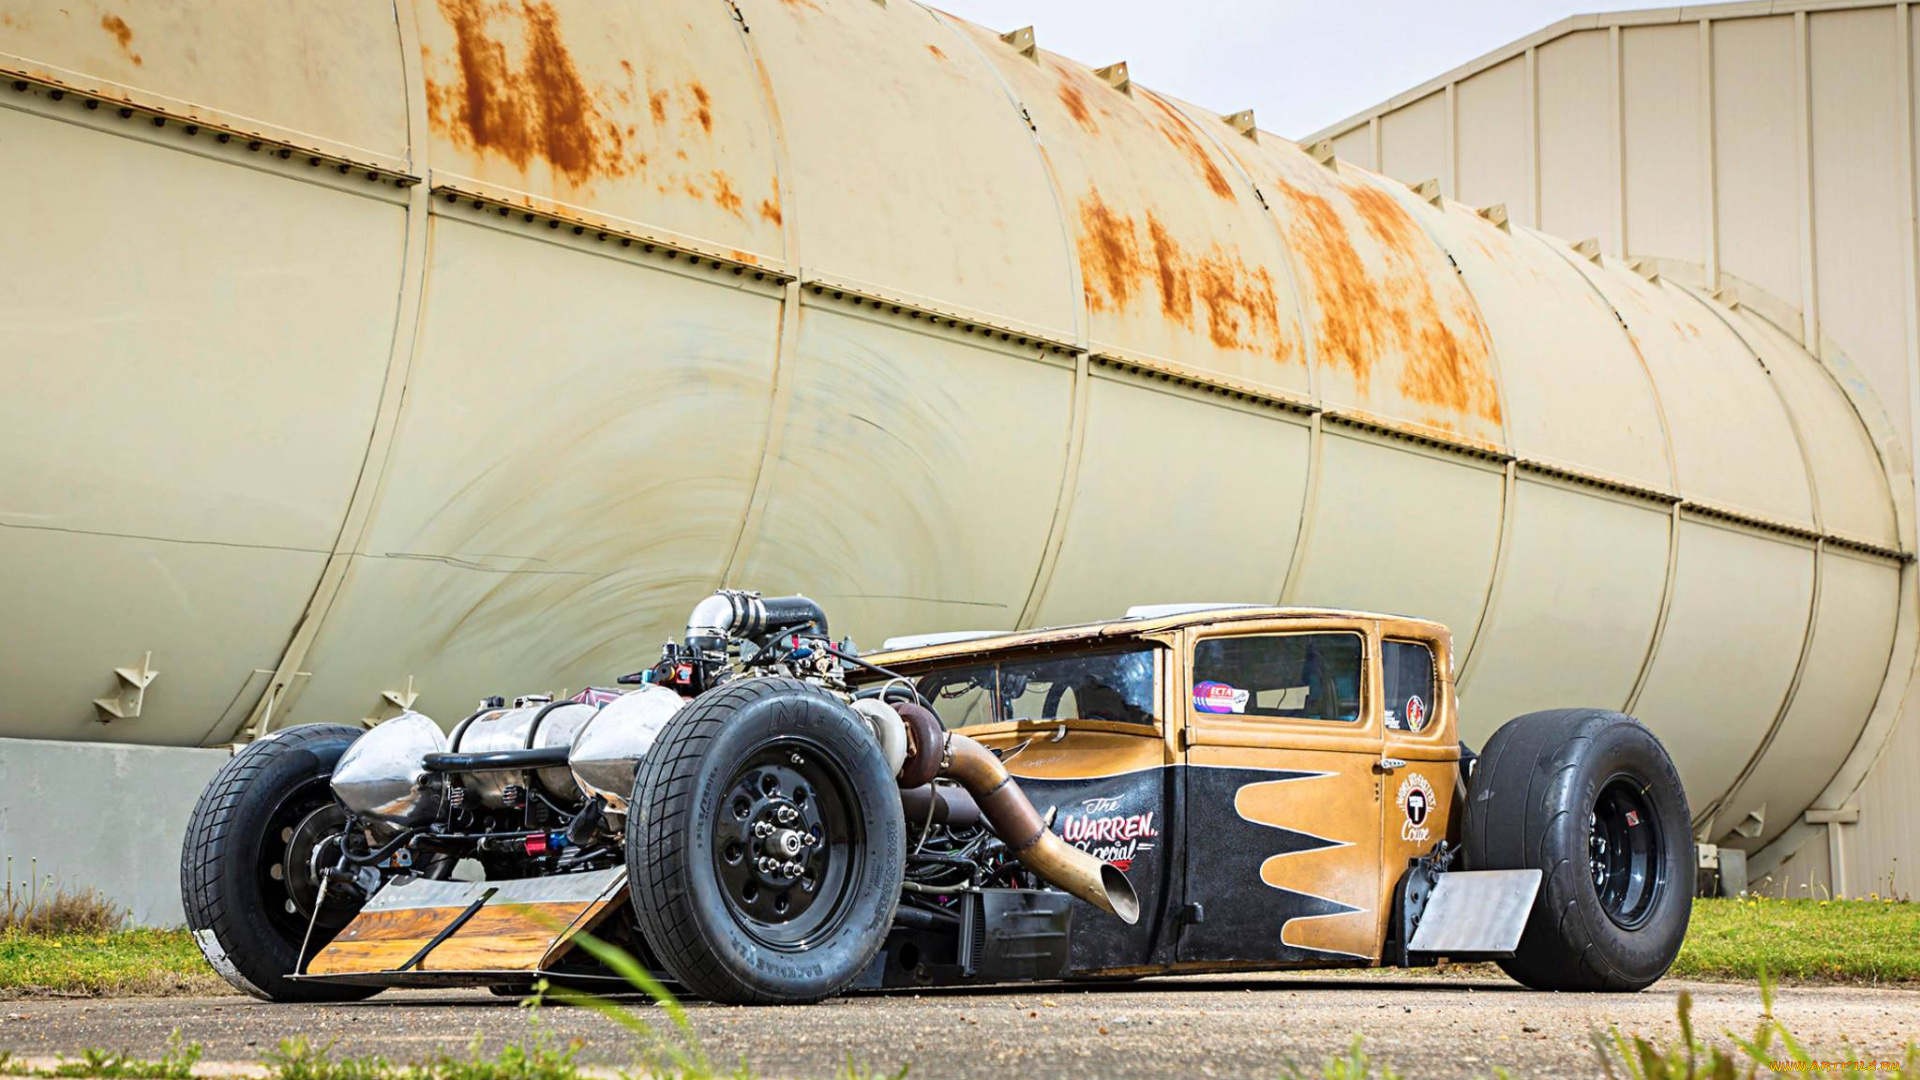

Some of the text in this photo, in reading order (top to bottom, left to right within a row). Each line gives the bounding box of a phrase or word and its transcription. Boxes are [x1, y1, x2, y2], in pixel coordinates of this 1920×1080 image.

[1082, 793, 1125, 814] The
[1409, 796, 1424, 822] T
[1401, 818, 1431, 848] Coupe
